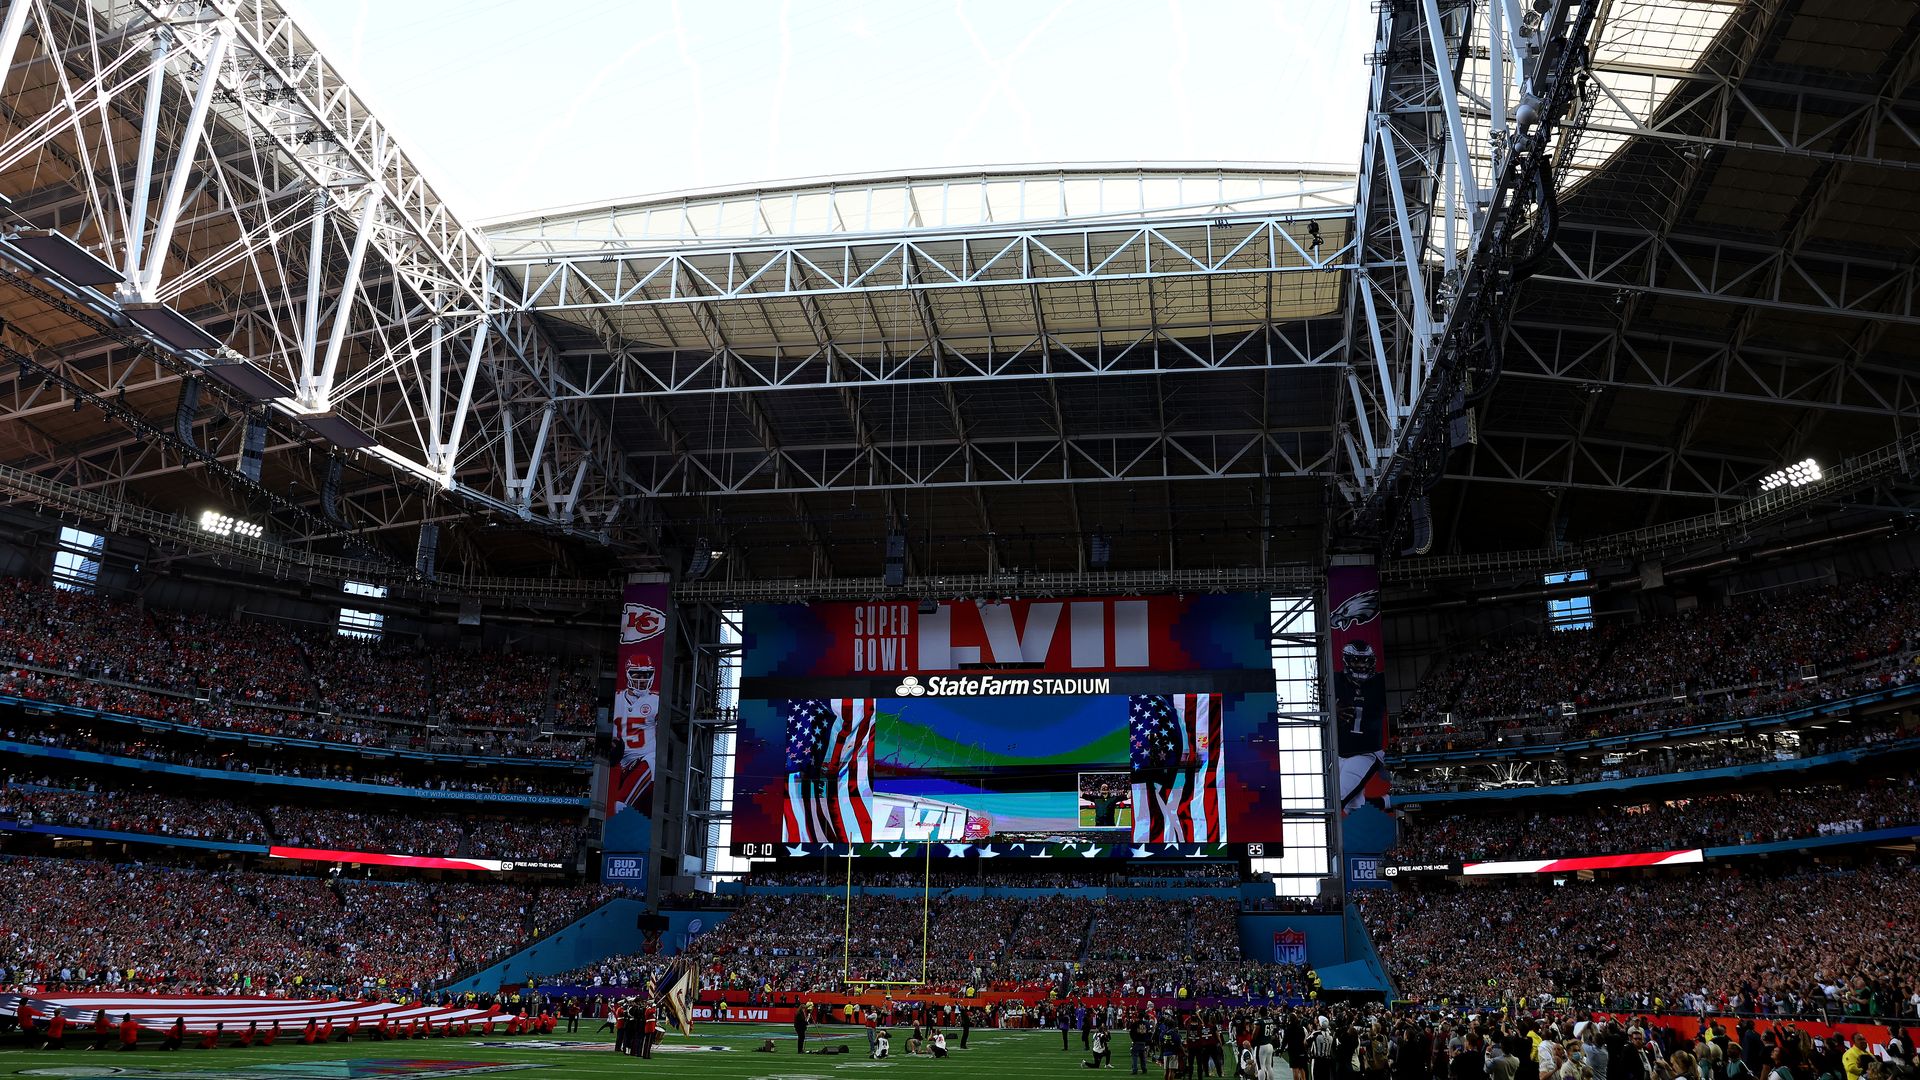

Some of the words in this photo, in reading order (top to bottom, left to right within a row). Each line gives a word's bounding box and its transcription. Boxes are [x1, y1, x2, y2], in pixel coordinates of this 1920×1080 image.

[855, 605, 909, 636] SUPER
[918, 600, 1149, 671] LVII
[854, 638, 908, 671] BOWL
[1032, 678, 1110, 694] STADIUM
[614, 717, 646, 749] 15
[1250, 844, 1262, 855] 25
[614, 860, 637, 868] BUD
[1358, 861, 1377, 870] BU
[609, 868, 640, 877] LIGHT
[1277, 945, 1304, 961] NFL
[738, 1009, 769, 1020] LVII
